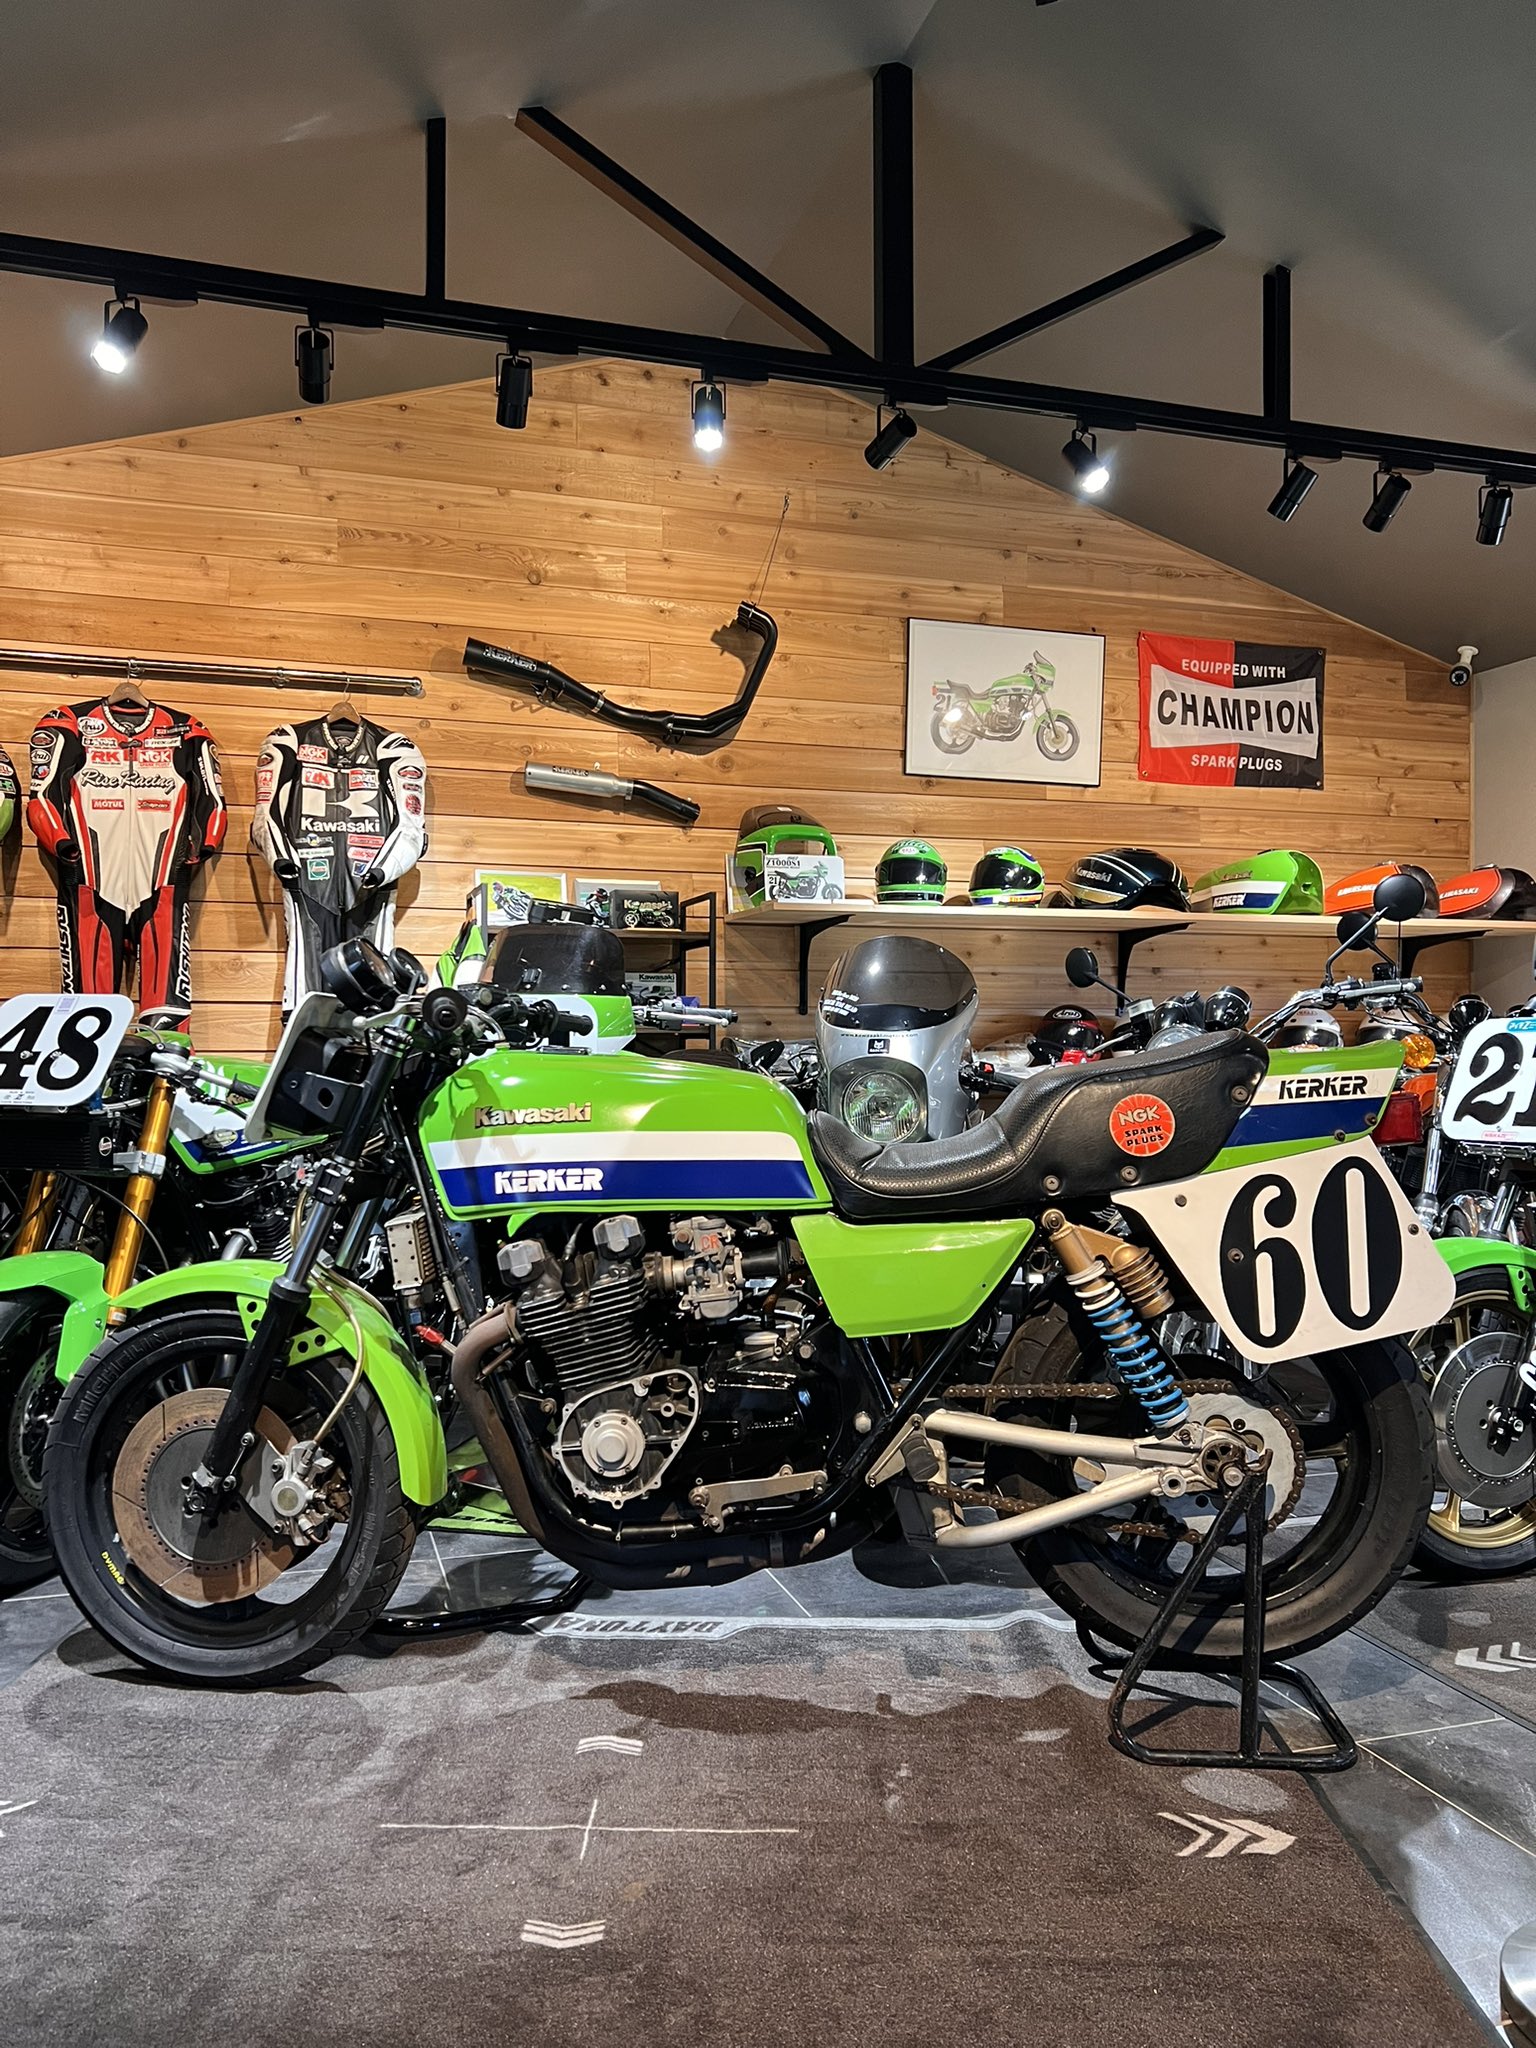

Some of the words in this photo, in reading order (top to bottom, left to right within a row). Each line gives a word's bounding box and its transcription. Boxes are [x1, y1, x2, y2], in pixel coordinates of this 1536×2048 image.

[1181, 659, 1249, 676] EQUIPPED
[1252, 665, 1286, 678] WITH
[1157, 689, 1314, 735] CHAMPION
[139, 751, 171, 762] NGK
[1191, 754, 1236, 768] SPARK
[1239, 757, 1283, 771] PLUGS
[81, 768, 119, 788] Rise
[120, 769, 176, 795] Racing
[301, 817, 380, 833] Kawasaki
[1213, 893, 1246, 908] KERKER
[0, 1006, 112, 1090] 48
[1279, 1075, 1368, 1100] KERKER
[475, 1102, 592, 1129] Kawasaki
[1118, 1105, 1161, 1126] NGK
[1125, 1125, 1162, 1137] SPARK
[1126, 1134, 1164, 1146] PLUGS
[494, 1168, 604, 1195] KERKER
[701, 1234, 720, 1250] CR
[1219, 1156, 1402, 1348] 60
